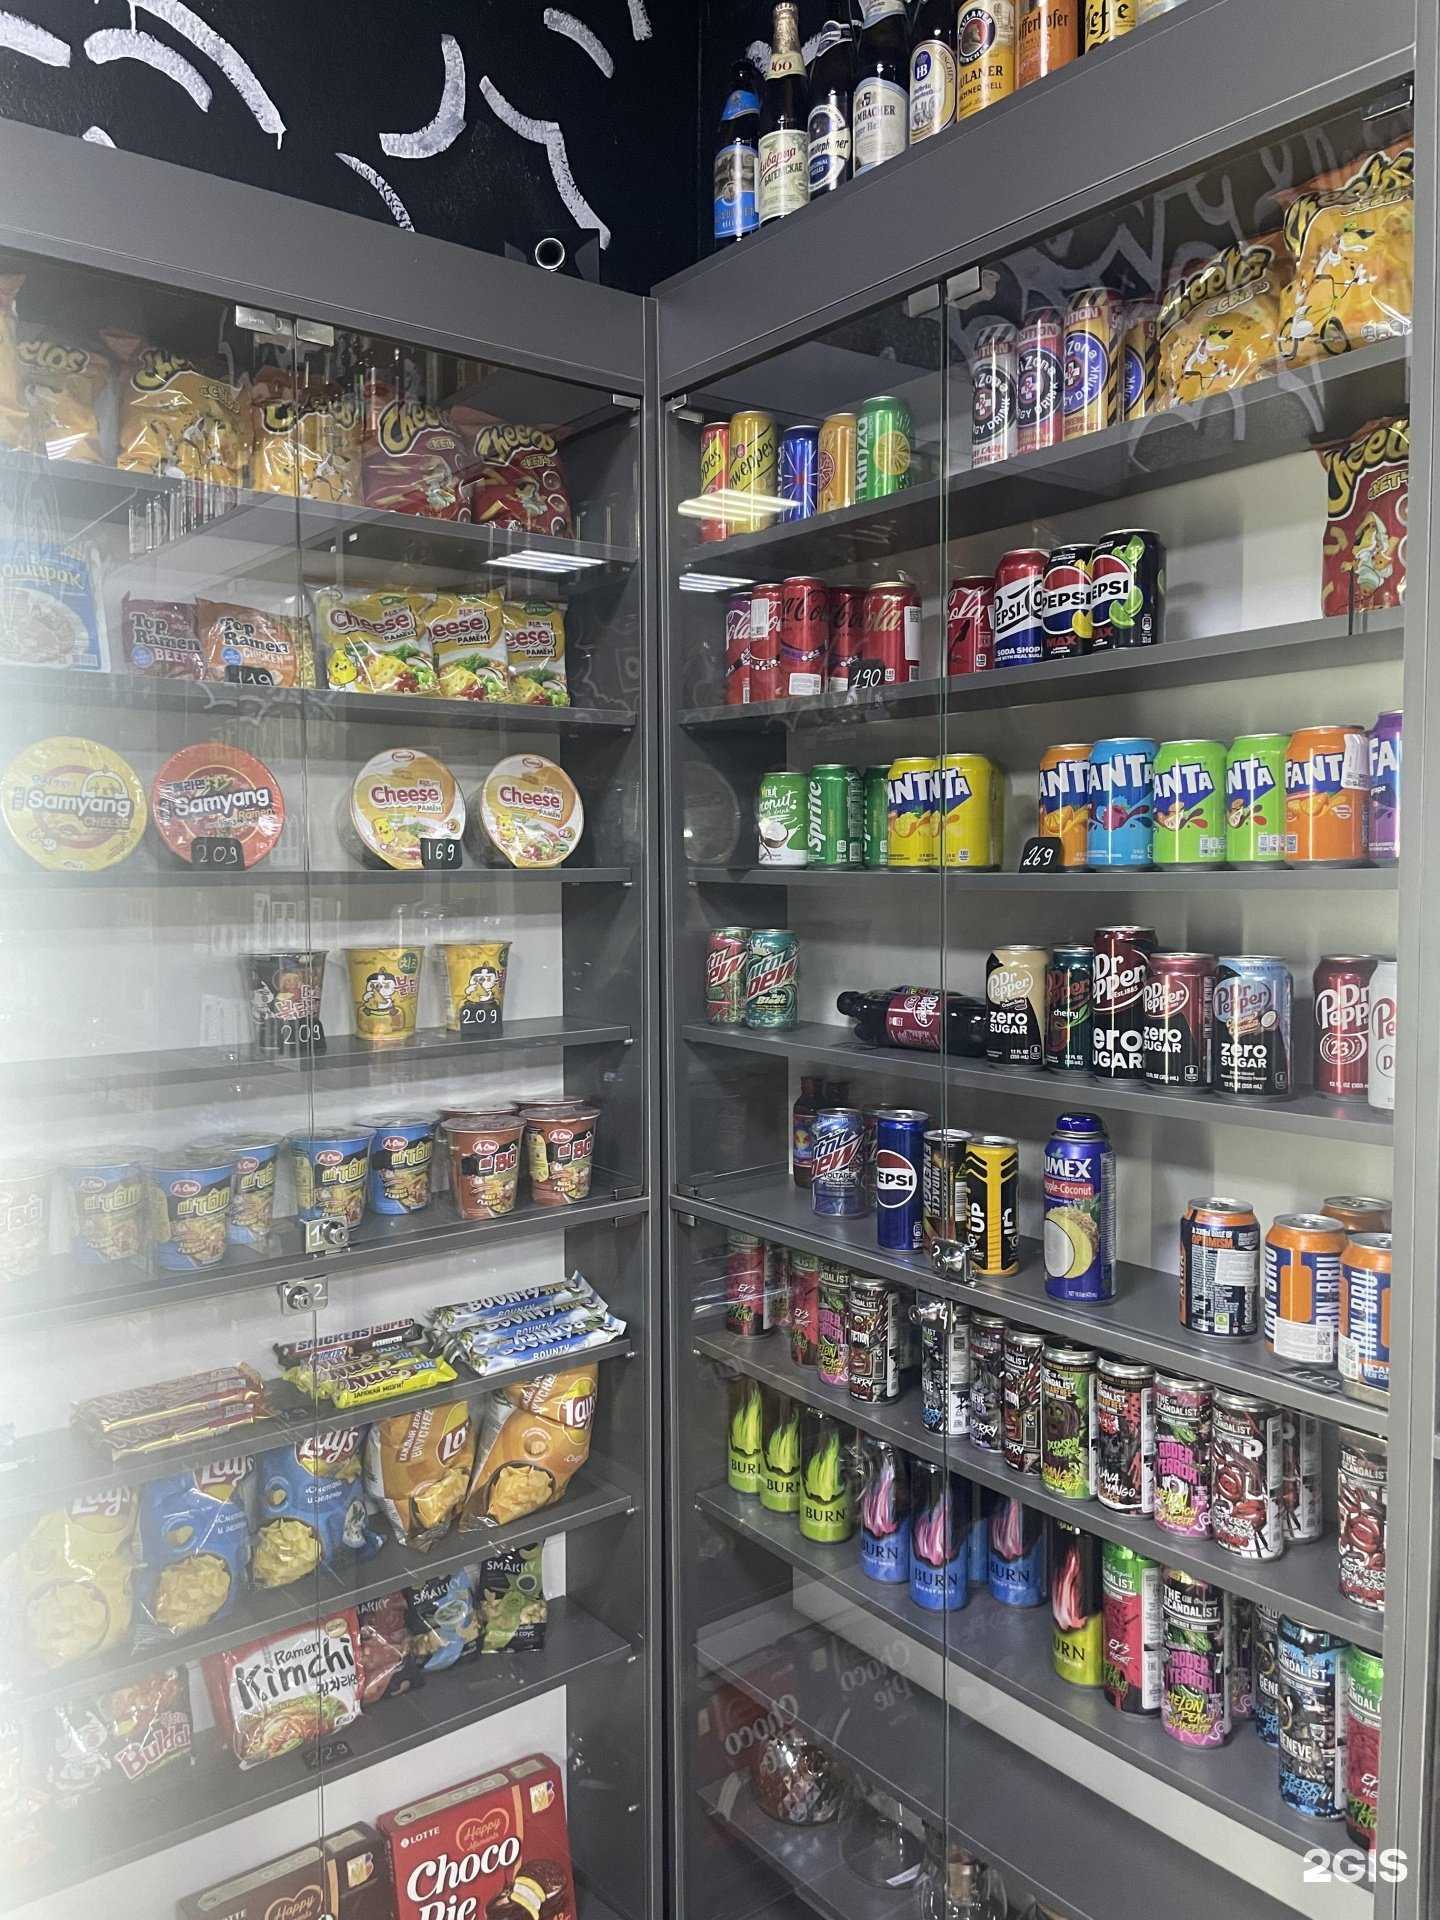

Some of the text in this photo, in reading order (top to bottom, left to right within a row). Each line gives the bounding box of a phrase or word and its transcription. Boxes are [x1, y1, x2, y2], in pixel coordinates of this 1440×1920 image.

[916, 64, 928, 80] HB
[960, 66, 1003, 88] ULANER
[1, 563, 85, 590] оширак
[1092, 580, 1128, 601] EPSI
[131, 613, 168, 633] Top
[221, 616, 254, 634] Top
[330, 609, 410, 635] Cheese
[431, 614, 485, 639] eese
[136, 629, 200, 651] Ramen
[225, 631, 288, 654] Ramen
[155, 647, 188, 662] BEEF
[243, 649, 286, 664] CHICKEN
[998, 646, 1041, 657] SODA SHOP
[853, 669, 882, 689] 190
[1040, 761, 1089, 798] ANT
[1089, 753, 1153, 795] ANTA
[1227, 759, 1274, 794] NTA
[1285, 753, 1344, 789] FANT
[889, 772, 930, 805] ANT
[930, 768, 971, 802] NTA
[1154, 764, 1213, 800] ANTA
[28, 790, 131, 818] Samyang
[175, 787, 270, 818] Samyang
[371, 786, 440, 804] Cheese
[499, 786, 560, 809] Cheese
[808, 780, 823, 852] Sprite
[199, 845, 238, 864] 209
[427, 842, 456, 861] 169
[1023, 846, 1054, 866] 269
[1095, 953, 1124, 983] Dr
[988, 974, 1029, 1000] Pepper
[463, 1009, 498, 1024] 209
[990, 1011, 1027, 1025] zero
[1053, 1010, 1079, 1019] cherry
[1316, 988, 1369, 1030] Pepp
[281, 1024, 321, 1045] 209
[990, 1024, 1027, 1035] SUGAR
[1093, 1028, 1143, 1052] ero
[1144, 1026, 1182, 1043] zero
[1144, 1041, 1182, 1054] SUGAR
[1221, 1042, 1267, 1058] zero
[1330, 1039, 1350, 1056] 23
[1093, 1051, 1144, 1069] UGAR
[1221, 1055, 1267, 1069] SUGAR
[823, 1171, 853, 1180] VOLTAGE
[1044, 1156, 1092, 1179] UMEX
[878, 1172, 913, 1187] EPSI
[971, 1203, 985, 1233] UP
[311, 1228, 323, 1246] 1
[313, 1284, 327, 1300] 2
[469, 1287, 541, 1312] BOUNTY
[516, 1321, 552, 1336] BOUNTY
[297, 1327, 370, 1352] SNICKERS
[533, 1344, 571, 1361] BOUNTY
[346, 1368, 399, 1392] Nuts
[767, 1478, 801, 1493] BURN
[805, 1506, 846, 1522] BURN
[914, 1569, 959, 1587] BURN
[1164, 1585, 1182, 1601] THE
[1164, 1599, 1220, 1618] SCANDALIST
[273, 1639, 322, 1665] Ramen
[1055, 1638, 1086, 1661] URN
[235, 1637, 354, 1711] Kimchi
[1280, 1656, 1327, 1681] ANDALIST
[410, 1826, 441, 1844] LOTTE
[464, 1818, 501, 1843] Happy
[407, 1836, 521, 1902] Choco
